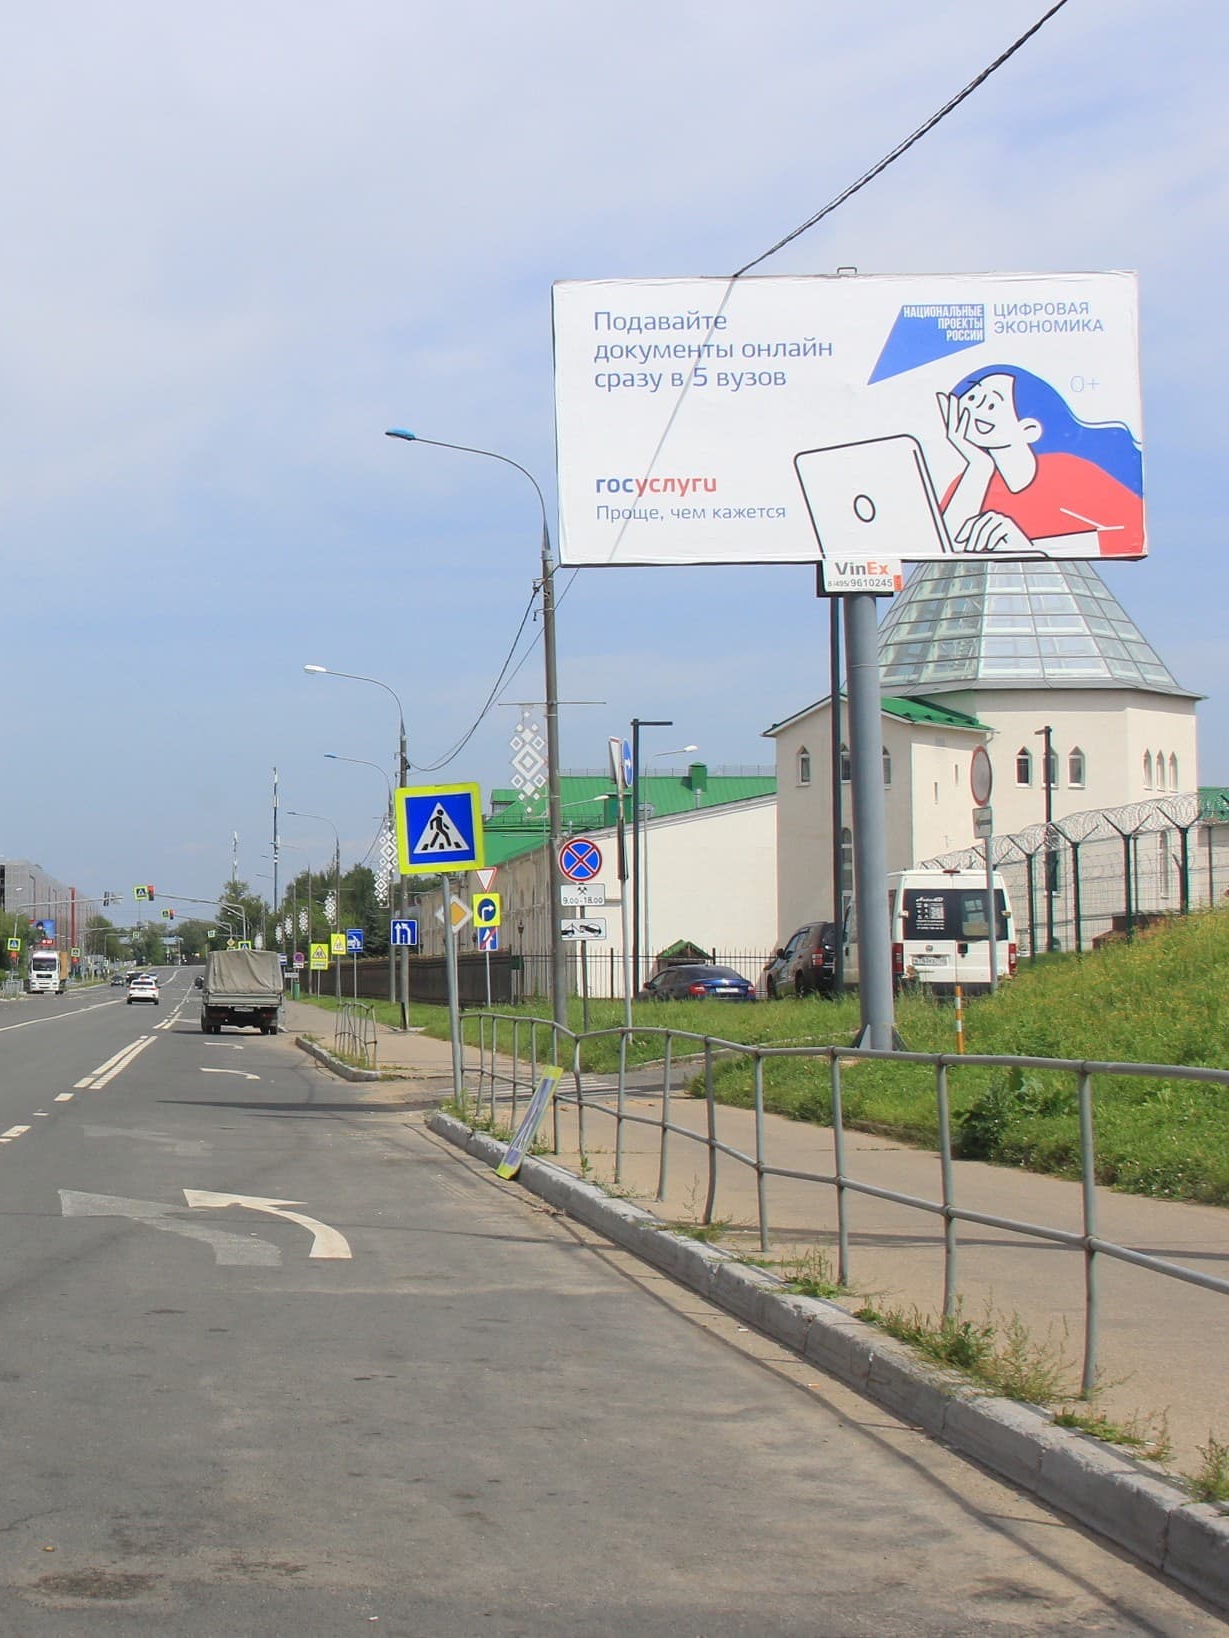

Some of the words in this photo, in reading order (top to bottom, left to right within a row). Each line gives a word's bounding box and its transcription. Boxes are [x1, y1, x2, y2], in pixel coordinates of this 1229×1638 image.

[903, 304, 983, 318] НАЦИОНАЛЬНЫЕ
[993, 302, 1089, 318] ЦИФРОВАЯ
[594, 310, 728, 334] Подавайте
[937, 317, 983, 330] ПРОЕКТЫ
[993, 319, 1104, 334] ЭКОНОМИКА
[946, 329, 984, 342] РОССИИ
[594, 343, 733, 364] документы
[741, 337, 833, 358] онлайн
[594, 370, 663, 393] сразу
[671, 372, 684, 387] в
[692, 367, 709, 387] 5
[716, 370, 787, 392] вузов
[1069, 374, 1101, 394] 0+
[595, 477, 717, 497] госуслуги
[596, 505, 665, 523] Проще,
[670, 507, 706, 520] чем
[712, 506, 786, 520] кажется
[834, 561, 889, 576] VinEx
